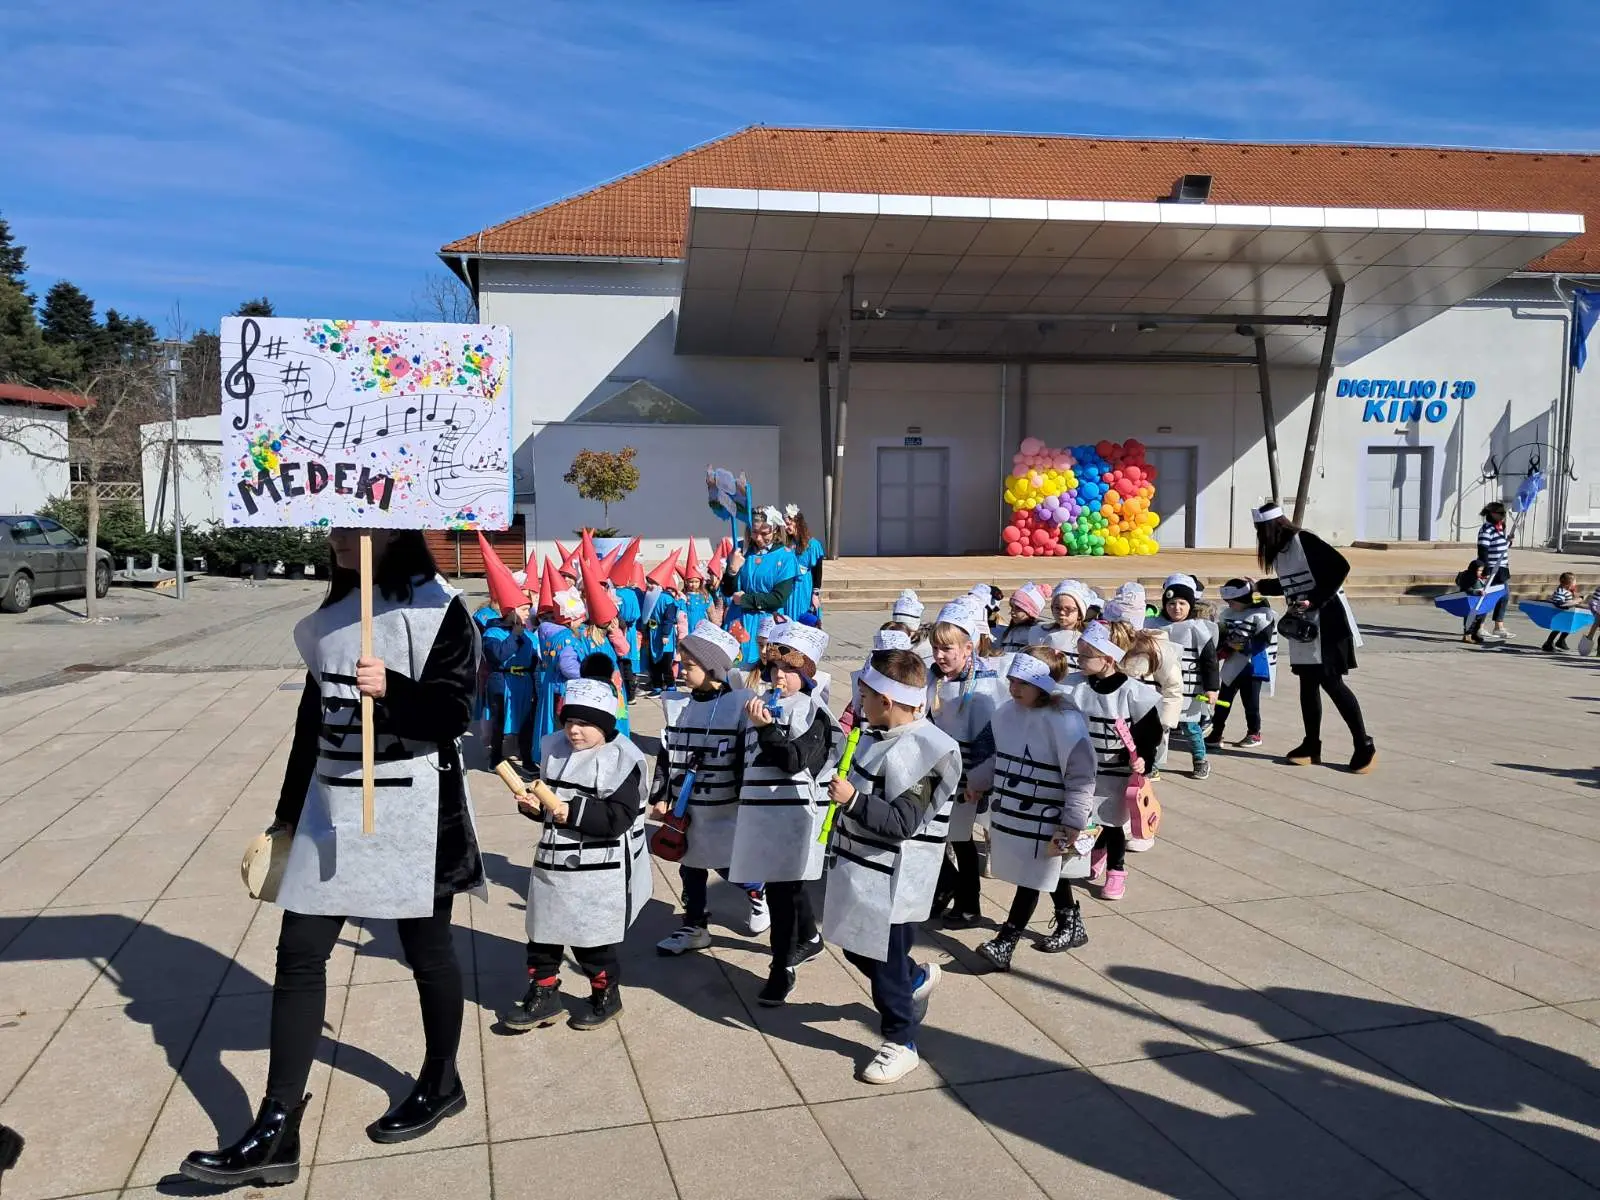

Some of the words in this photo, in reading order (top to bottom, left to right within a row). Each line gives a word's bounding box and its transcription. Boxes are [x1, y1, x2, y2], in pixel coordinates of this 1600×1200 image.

[1336, 379, 1436, 399] DIGITALNO
[1439, 380, 1448, 399] I
[1450, 380, 1476, 400] 3D
[1362, 399, 1448, 423] KINO
[237, 460, 395, 515] MEDEKI
